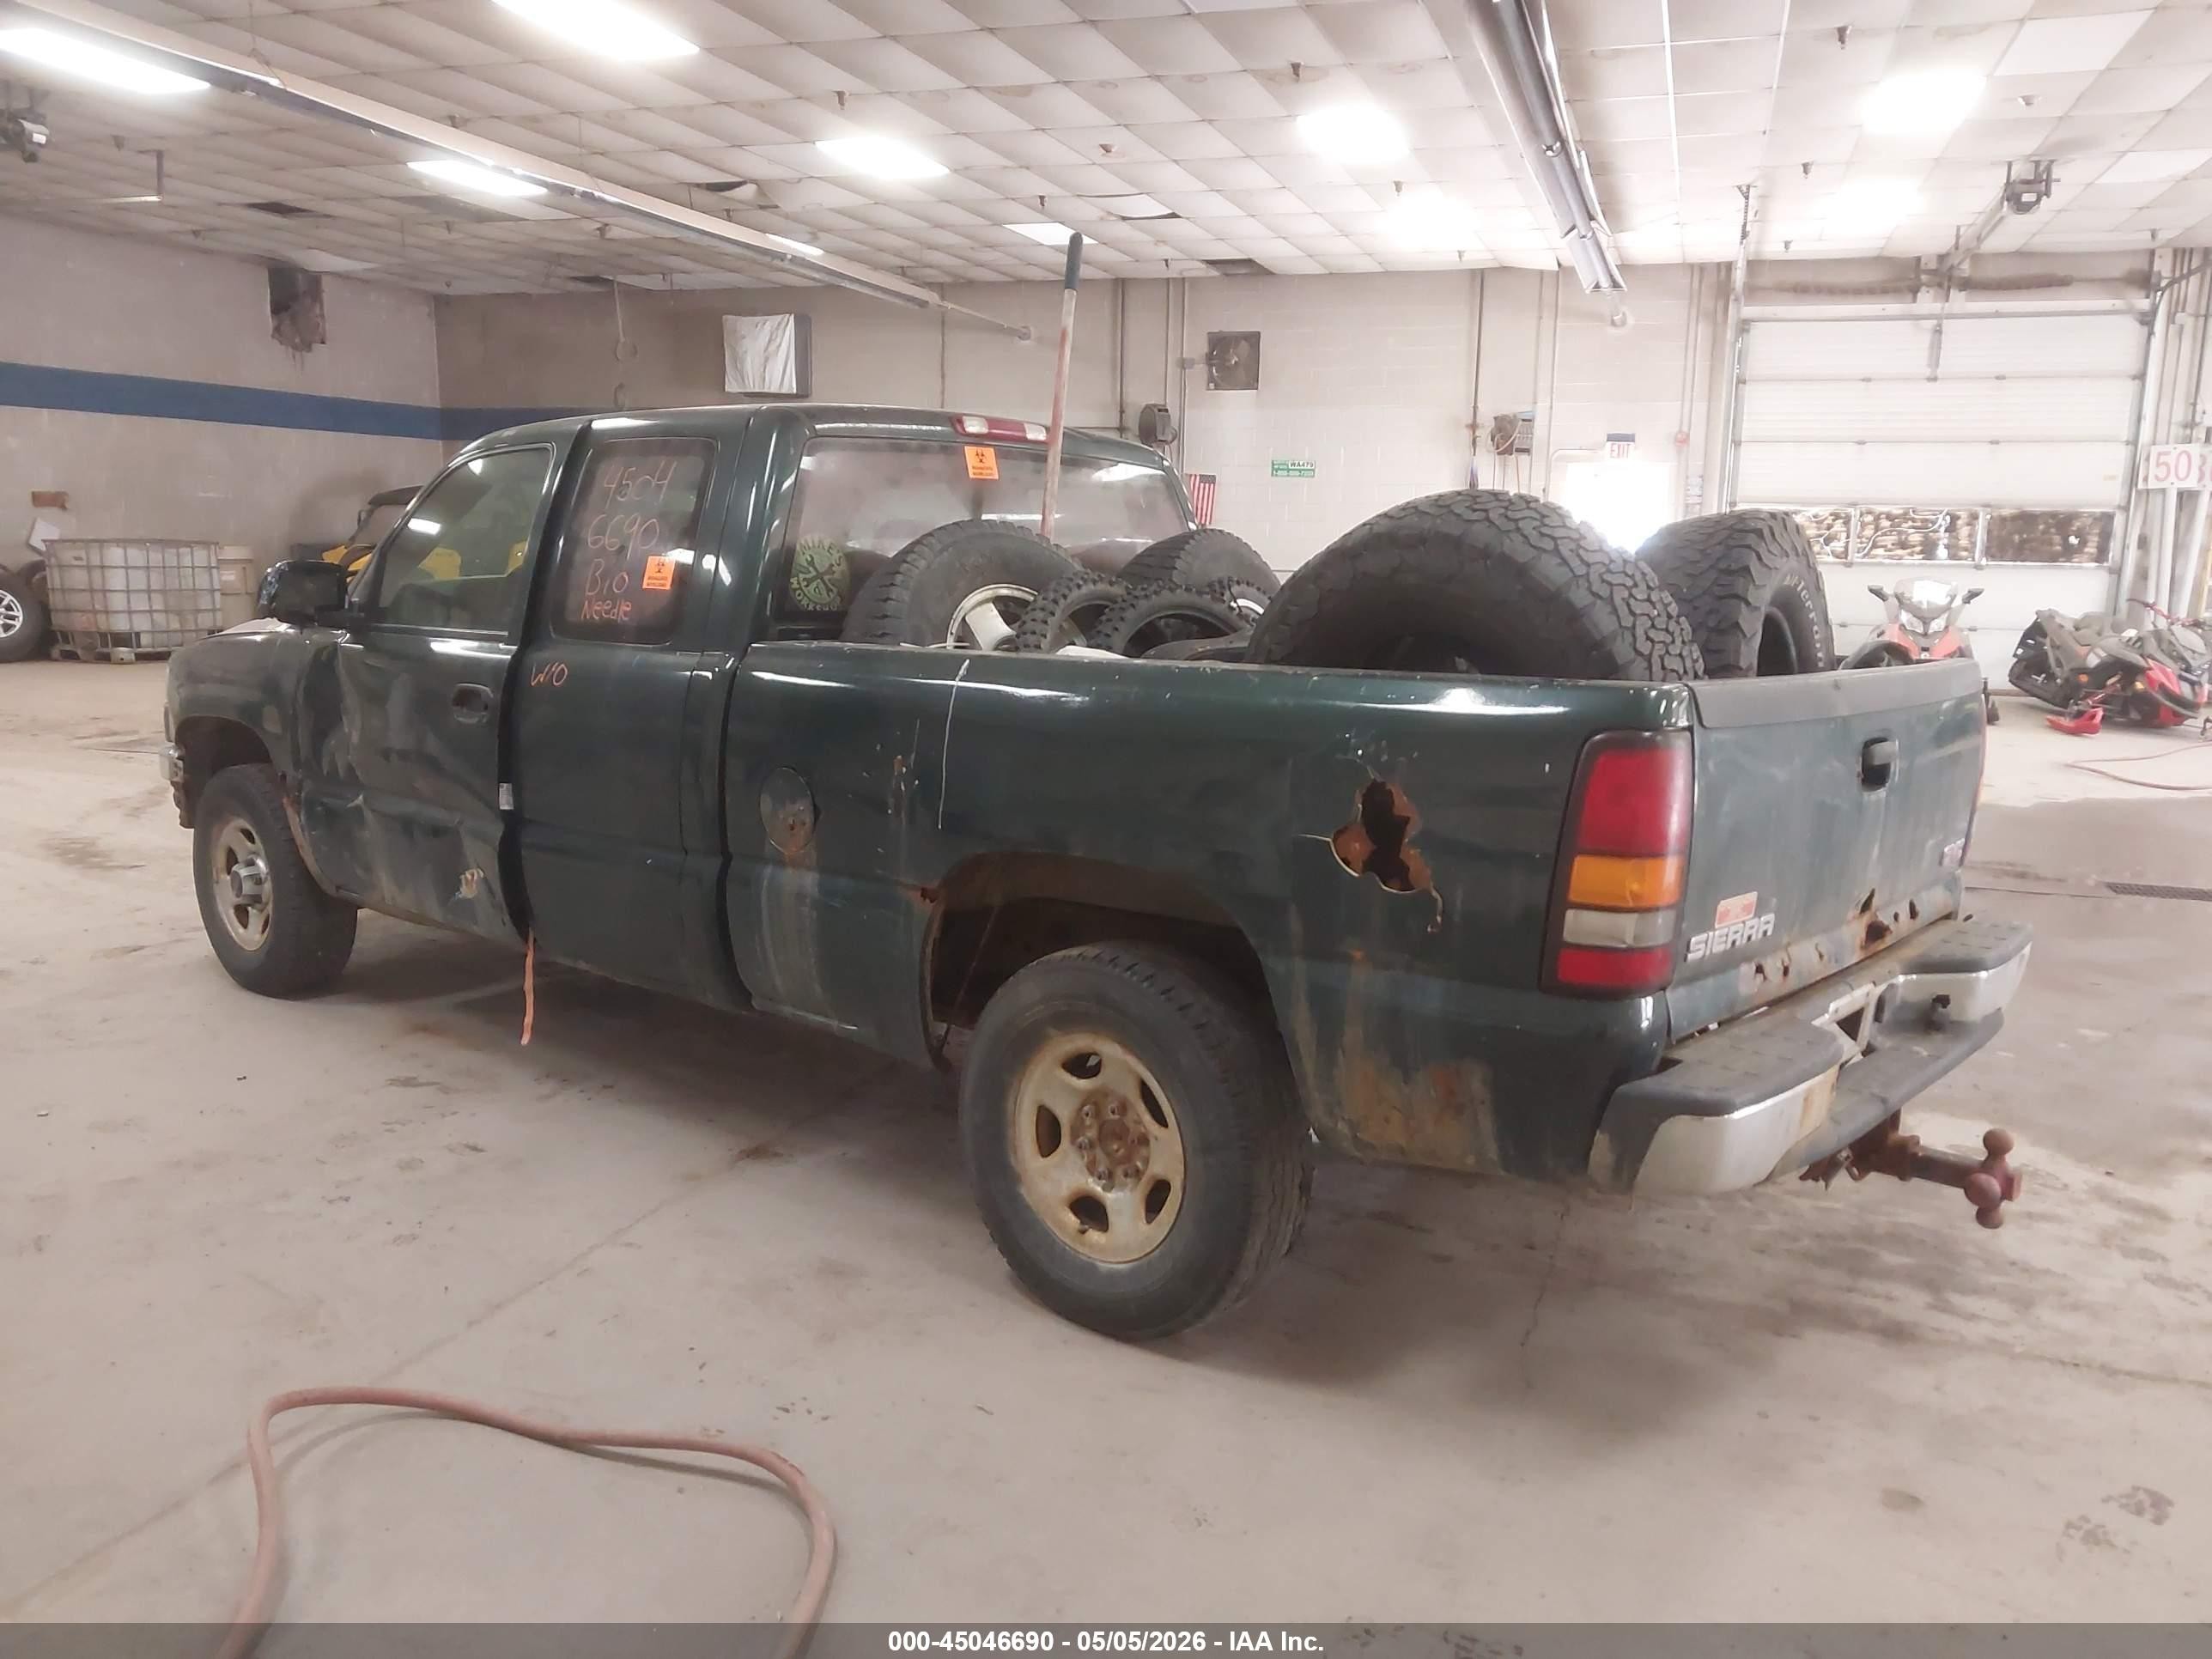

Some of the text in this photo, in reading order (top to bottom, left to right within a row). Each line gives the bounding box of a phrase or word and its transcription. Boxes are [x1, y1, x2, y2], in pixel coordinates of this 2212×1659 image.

[603, 460, 678, 510] 4504
[2154, 449, 2192, 482] 50
[587, 513, 659, 561] 6690
[585, 558, 629, 596] Bio
[580, 599, 633, 623] Needle
[1686, 913, 1775, 962] SIERRA
